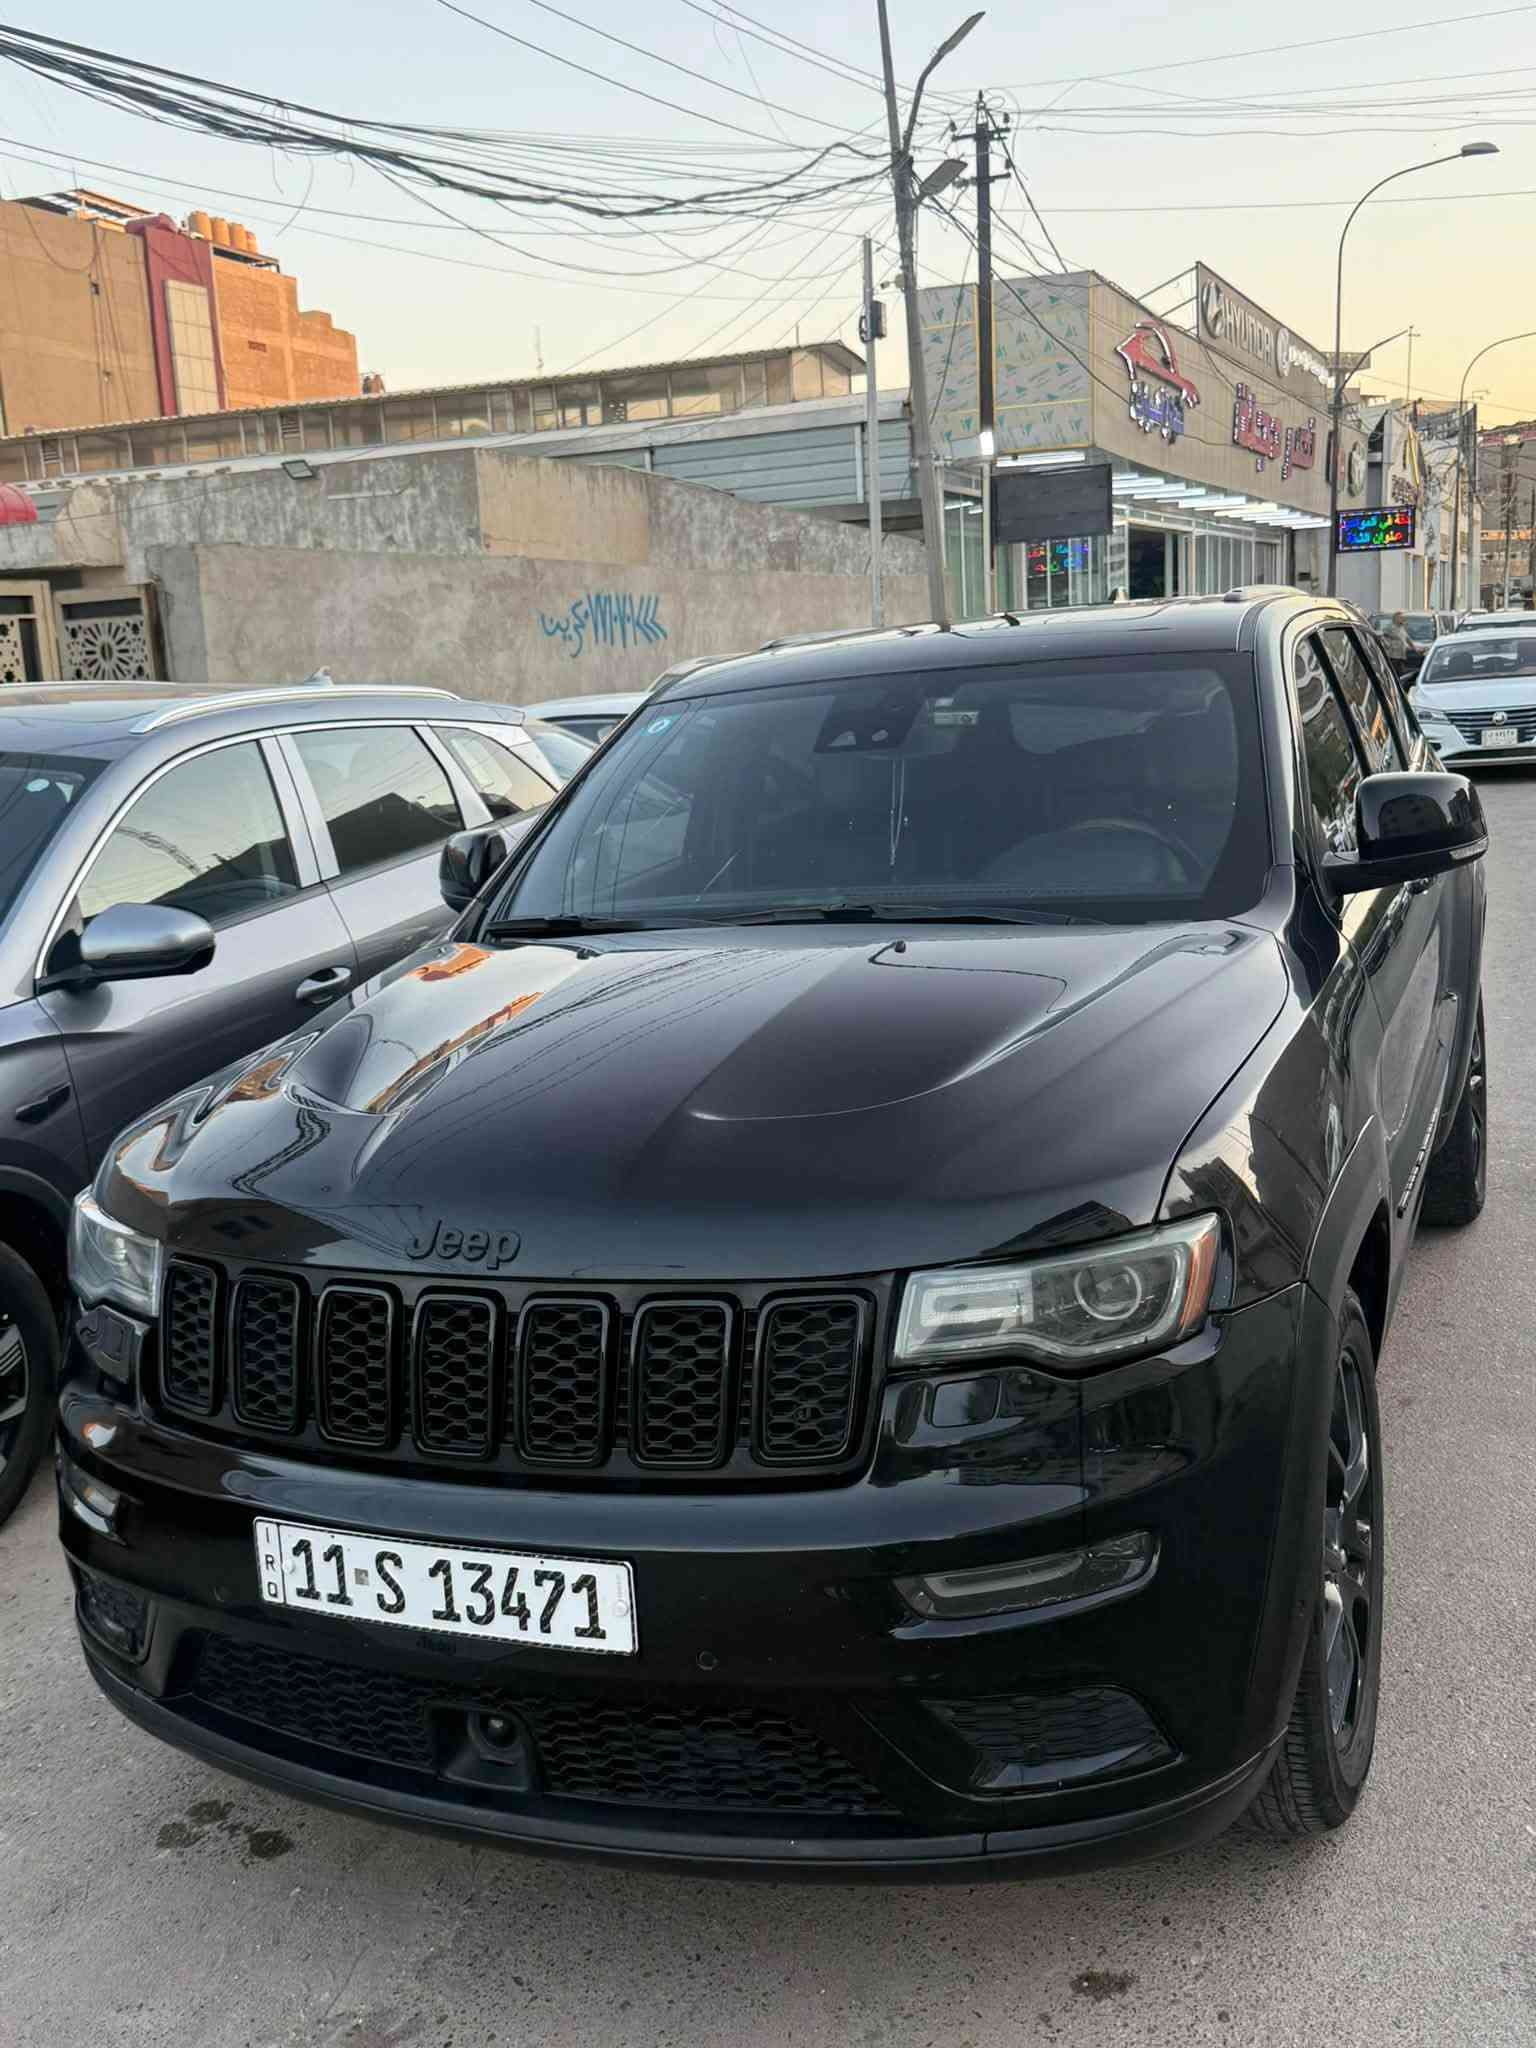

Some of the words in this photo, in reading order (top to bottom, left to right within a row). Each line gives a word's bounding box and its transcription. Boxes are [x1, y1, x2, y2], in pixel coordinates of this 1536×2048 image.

[1224, 298, 1275, 368] HYUNDAI
[406, 1219, 521, 1271] Jeep
[428, 1558, 608, 1640] 13471
